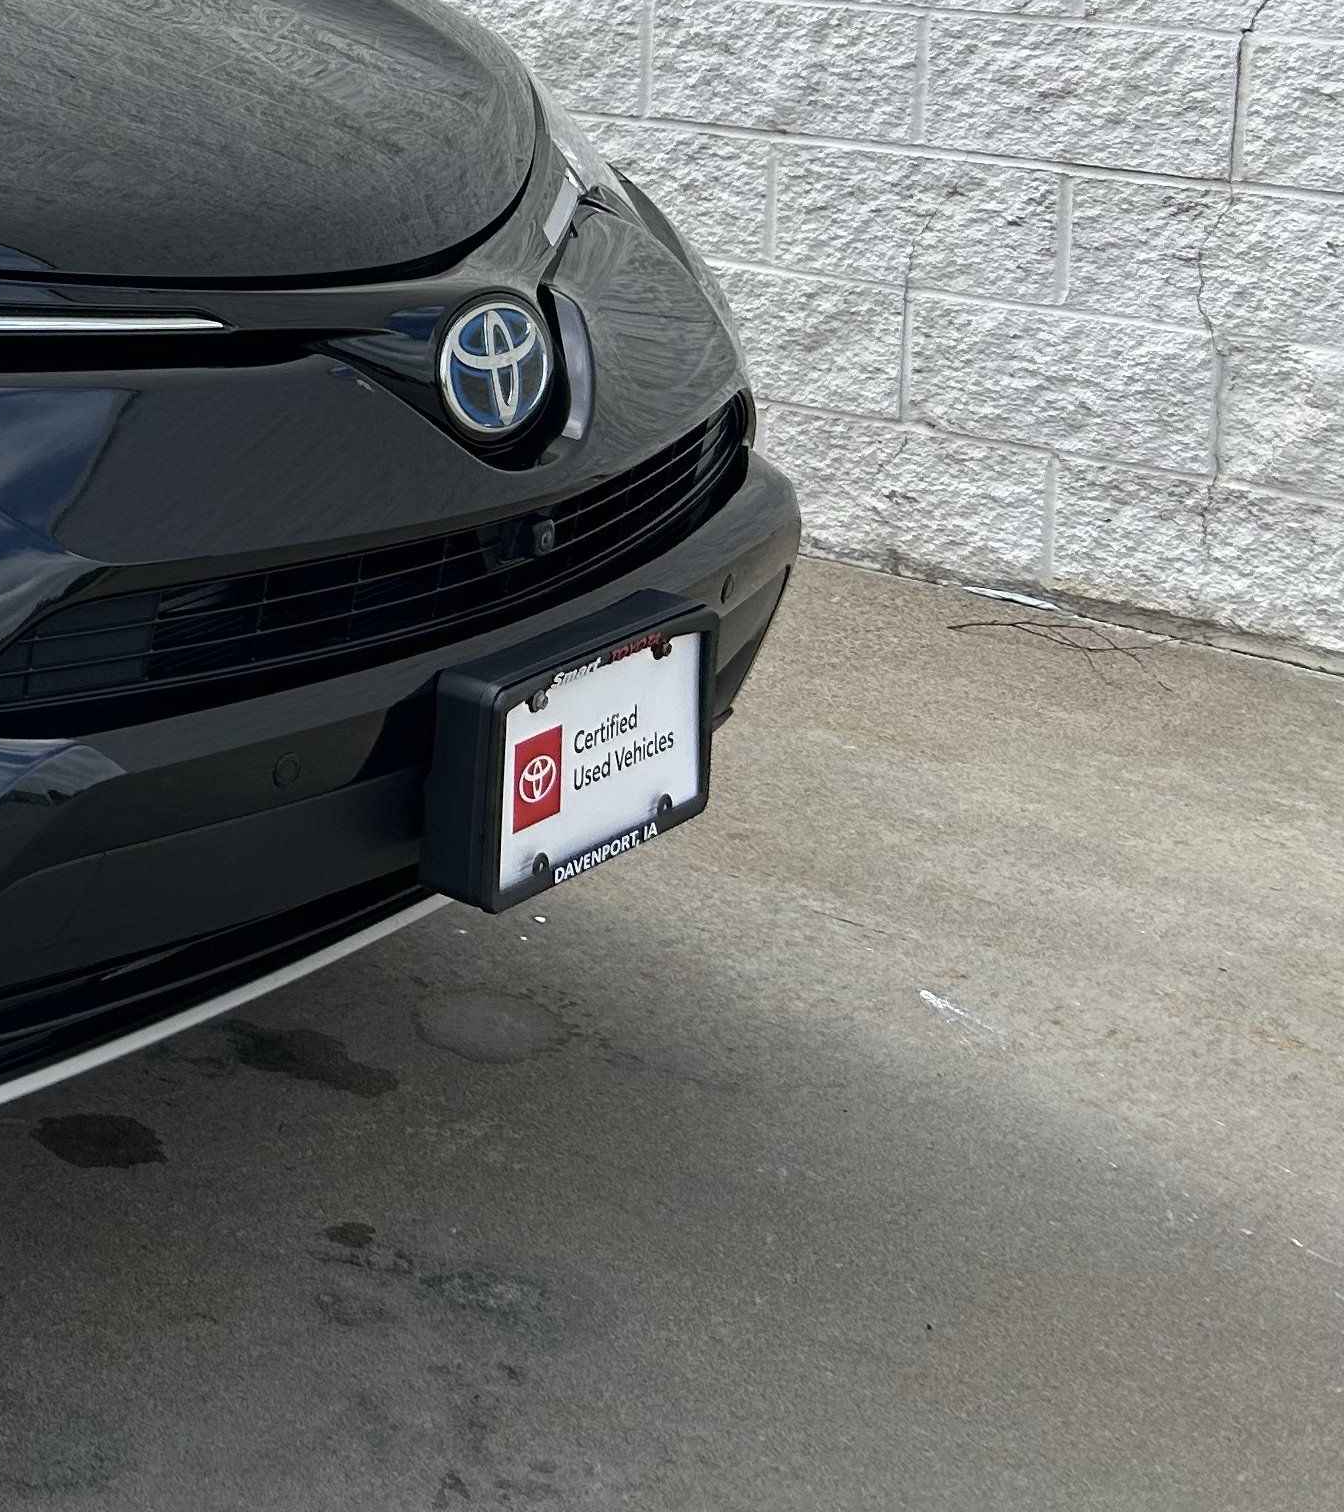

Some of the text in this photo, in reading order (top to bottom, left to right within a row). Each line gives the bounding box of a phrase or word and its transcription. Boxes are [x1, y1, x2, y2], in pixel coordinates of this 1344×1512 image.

[551, 656, 602, 689] Smart
[573, 703, 638, 754] Certified
[573, 731, 674, 791] Used Vehicles
[554, 821, 658, 884] DAVENPORT, IA
